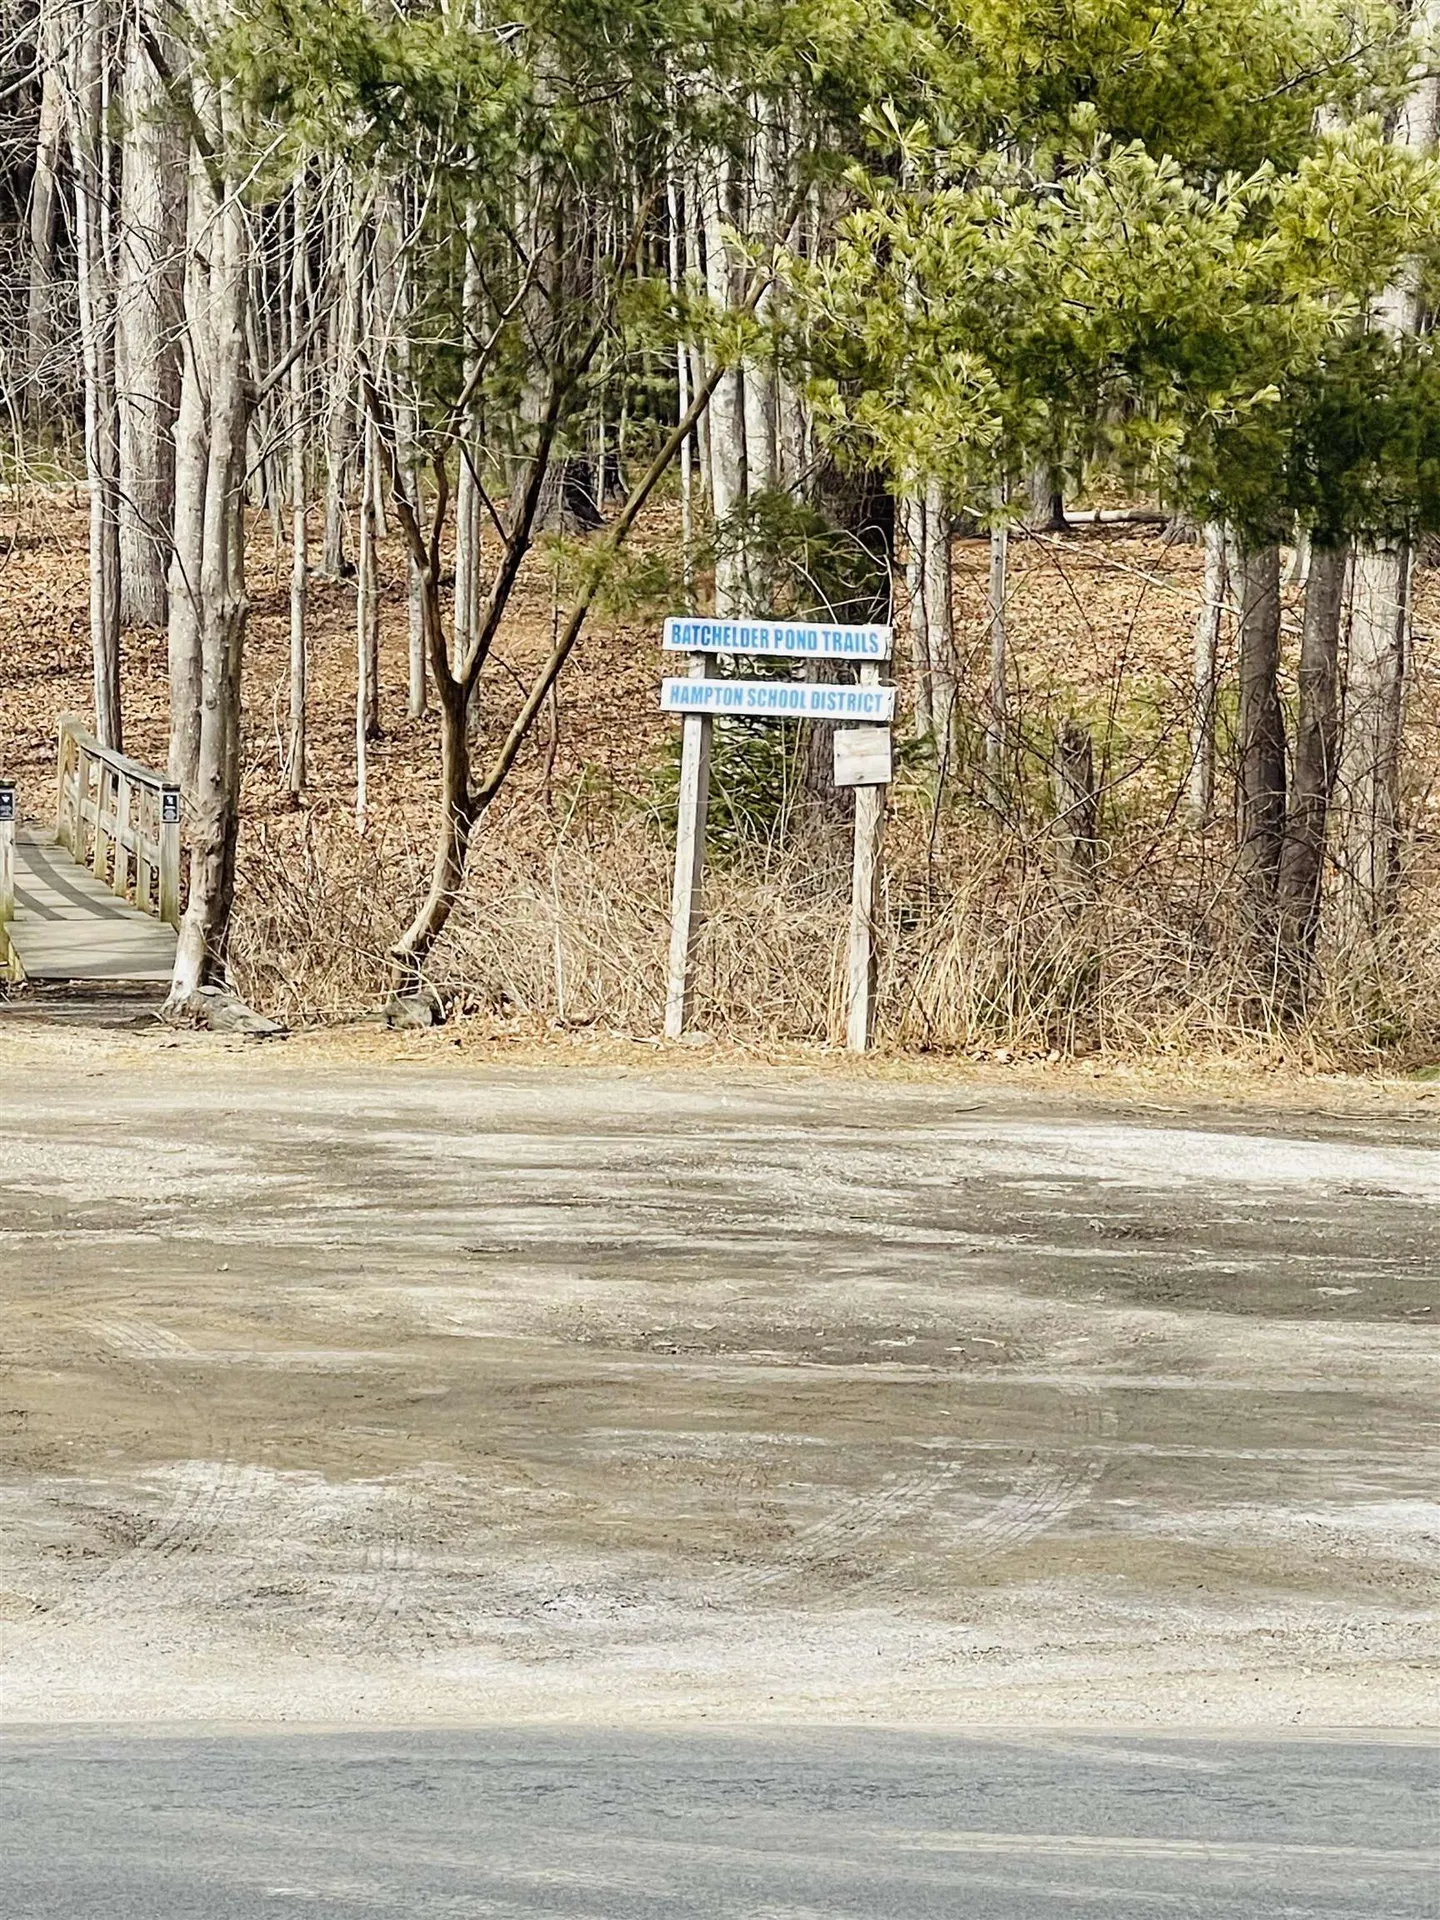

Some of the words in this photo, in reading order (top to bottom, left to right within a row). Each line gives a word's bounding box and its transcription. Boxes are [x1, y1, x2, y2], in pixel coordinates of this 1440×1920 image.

[671, 624, 769, 648] BATCHELDER
[774, 628, 817, 650] POND
[822, 631, 879, 653] TRAILS
[670, 684, 742, 706] HAMPTON
[747, 687, 807, 709] SCHOOL
[811, 691, 883, 712] DISTRICT
